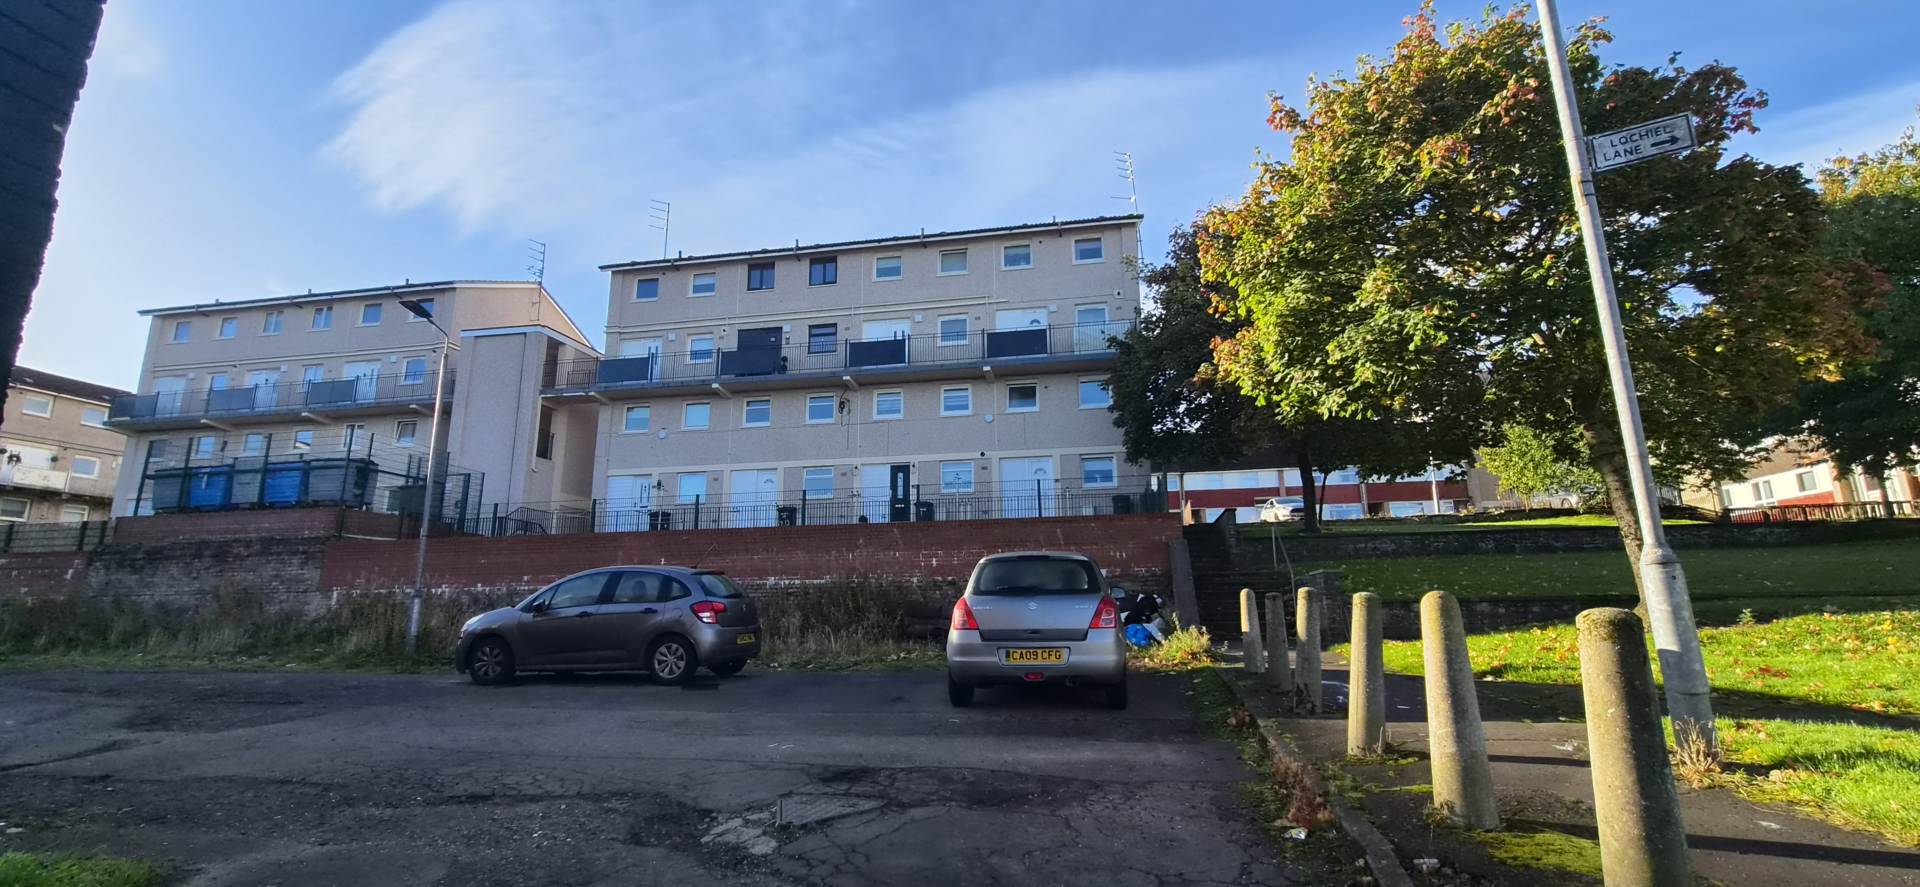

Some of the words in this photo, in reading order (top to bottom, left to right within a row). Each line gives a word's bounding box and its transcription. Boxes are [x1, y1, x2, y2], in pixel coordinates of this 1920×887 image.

[1610, 126, 1674, 147] LOCHIEL
[1603, 145, 1643, 161] LANE
[1011, 650, 1039, 660] CA09
[1041, 650, 1062, 660] CFG
